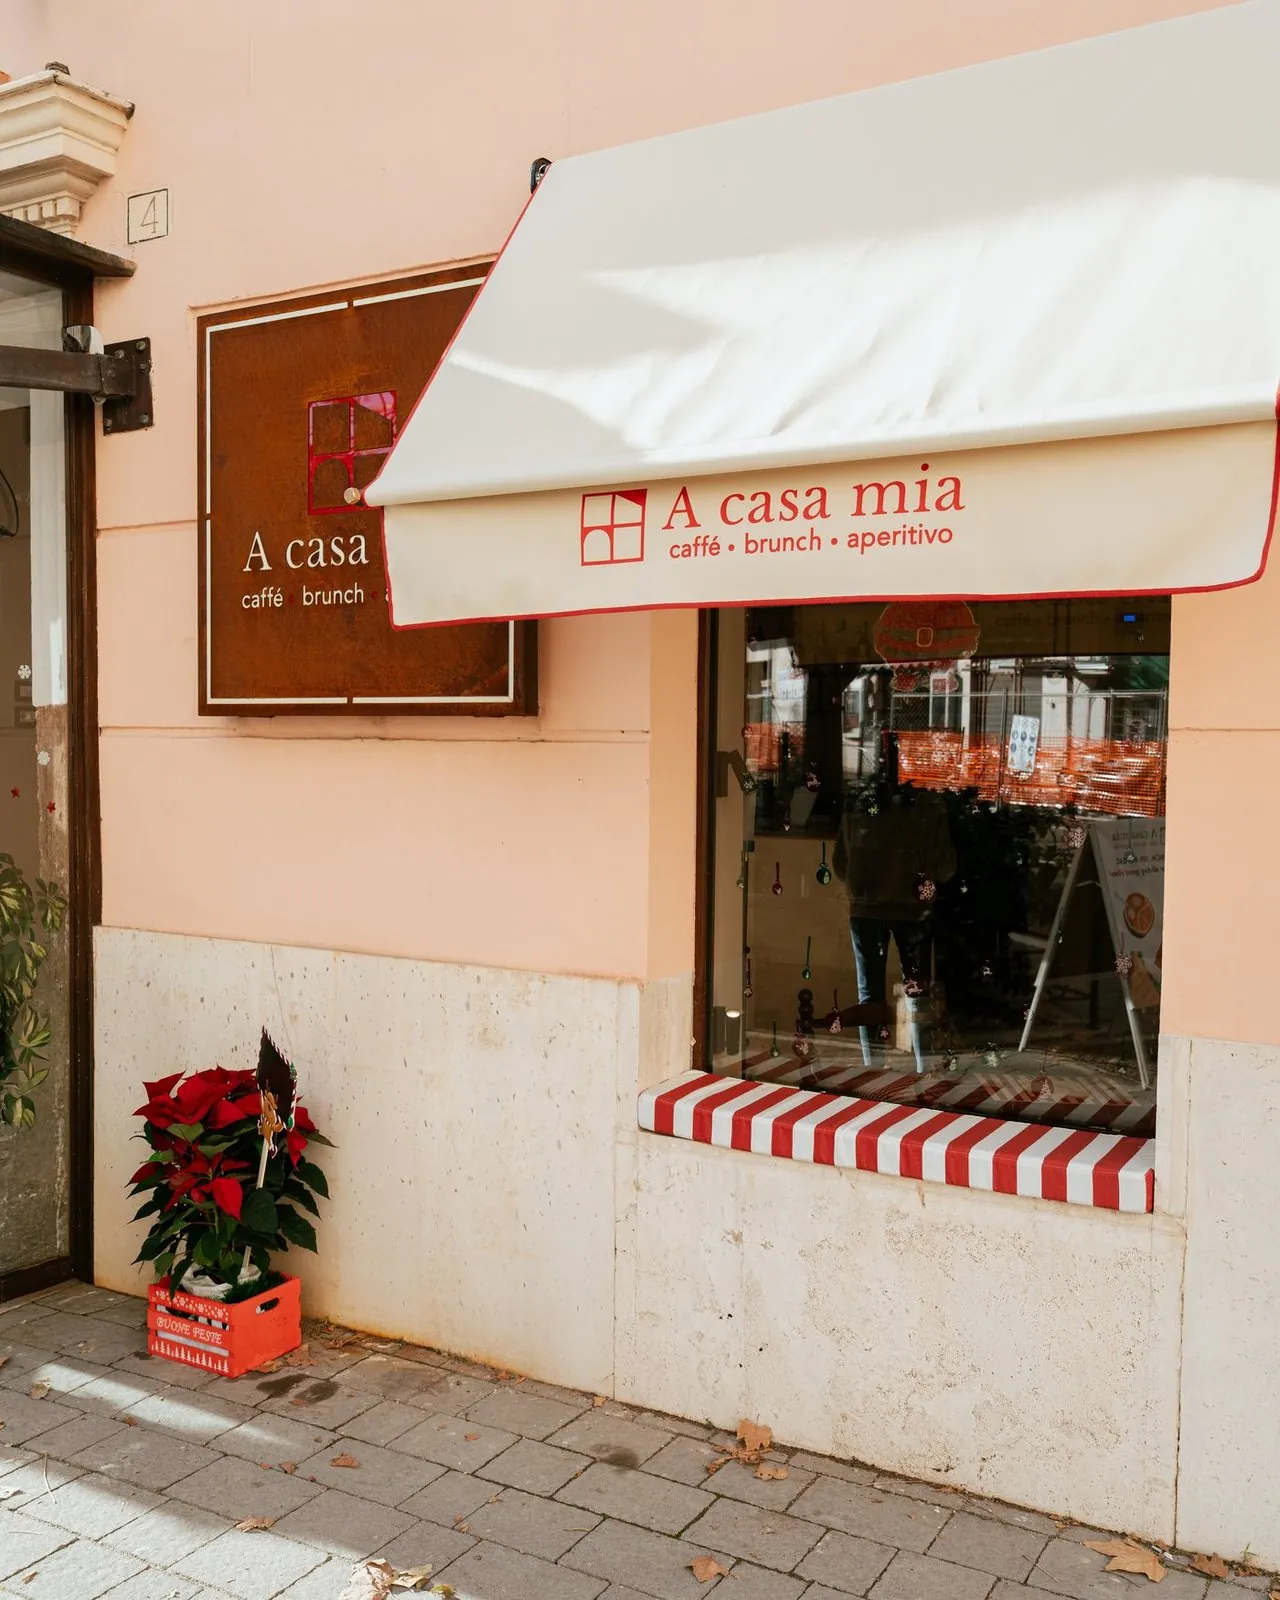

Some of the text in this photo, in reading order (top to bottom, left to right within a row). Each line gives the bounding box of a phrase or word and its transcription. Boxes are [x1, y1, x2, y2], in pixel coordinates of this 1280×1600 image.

[140, 195, 160, 234] 4
[661, 463, 966, 530] A casa mia
[242, 531, 369, 572] A casa
[669, 523, 953, 559] caffé brunch aperitivo
[241, 586, 283, 609] caffé
[302, 583, 364, 606] brunch
[156, 1316, 223, 1345] BUONE FESTE
